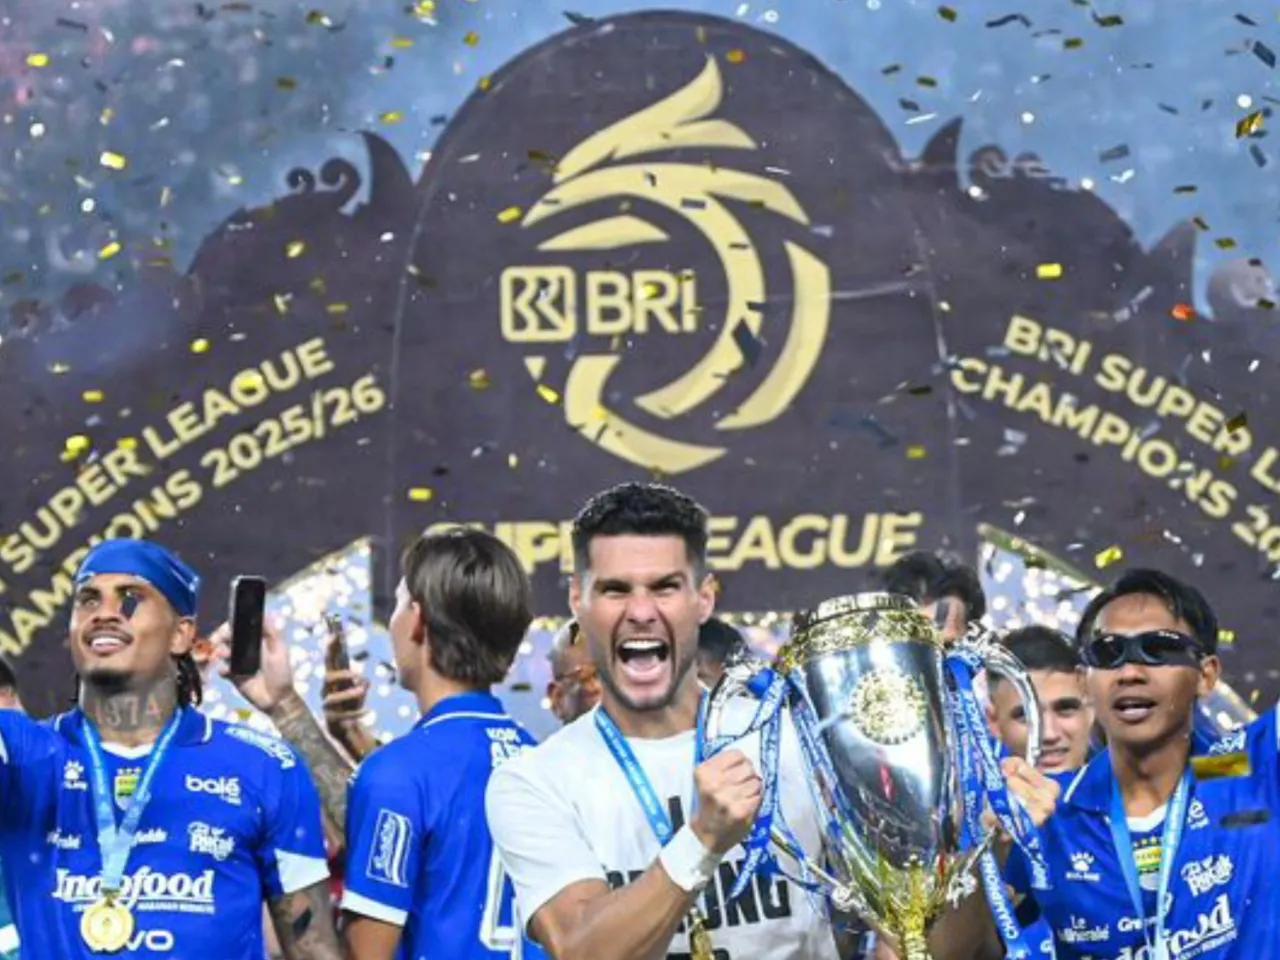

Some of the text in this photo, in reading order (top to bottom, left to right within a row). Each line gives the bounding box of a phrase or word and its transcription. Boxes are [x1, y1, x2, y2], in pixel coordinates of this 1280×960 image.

[141, 337, 335, 459] LEAGUE
[200, 374, 387, 488] 2025/26
[950, 357, 1239, 518] CHAMPIONS
[1094, 353, 1252, 456] SUPER
[706, 511, 923, 571] EAGUE
